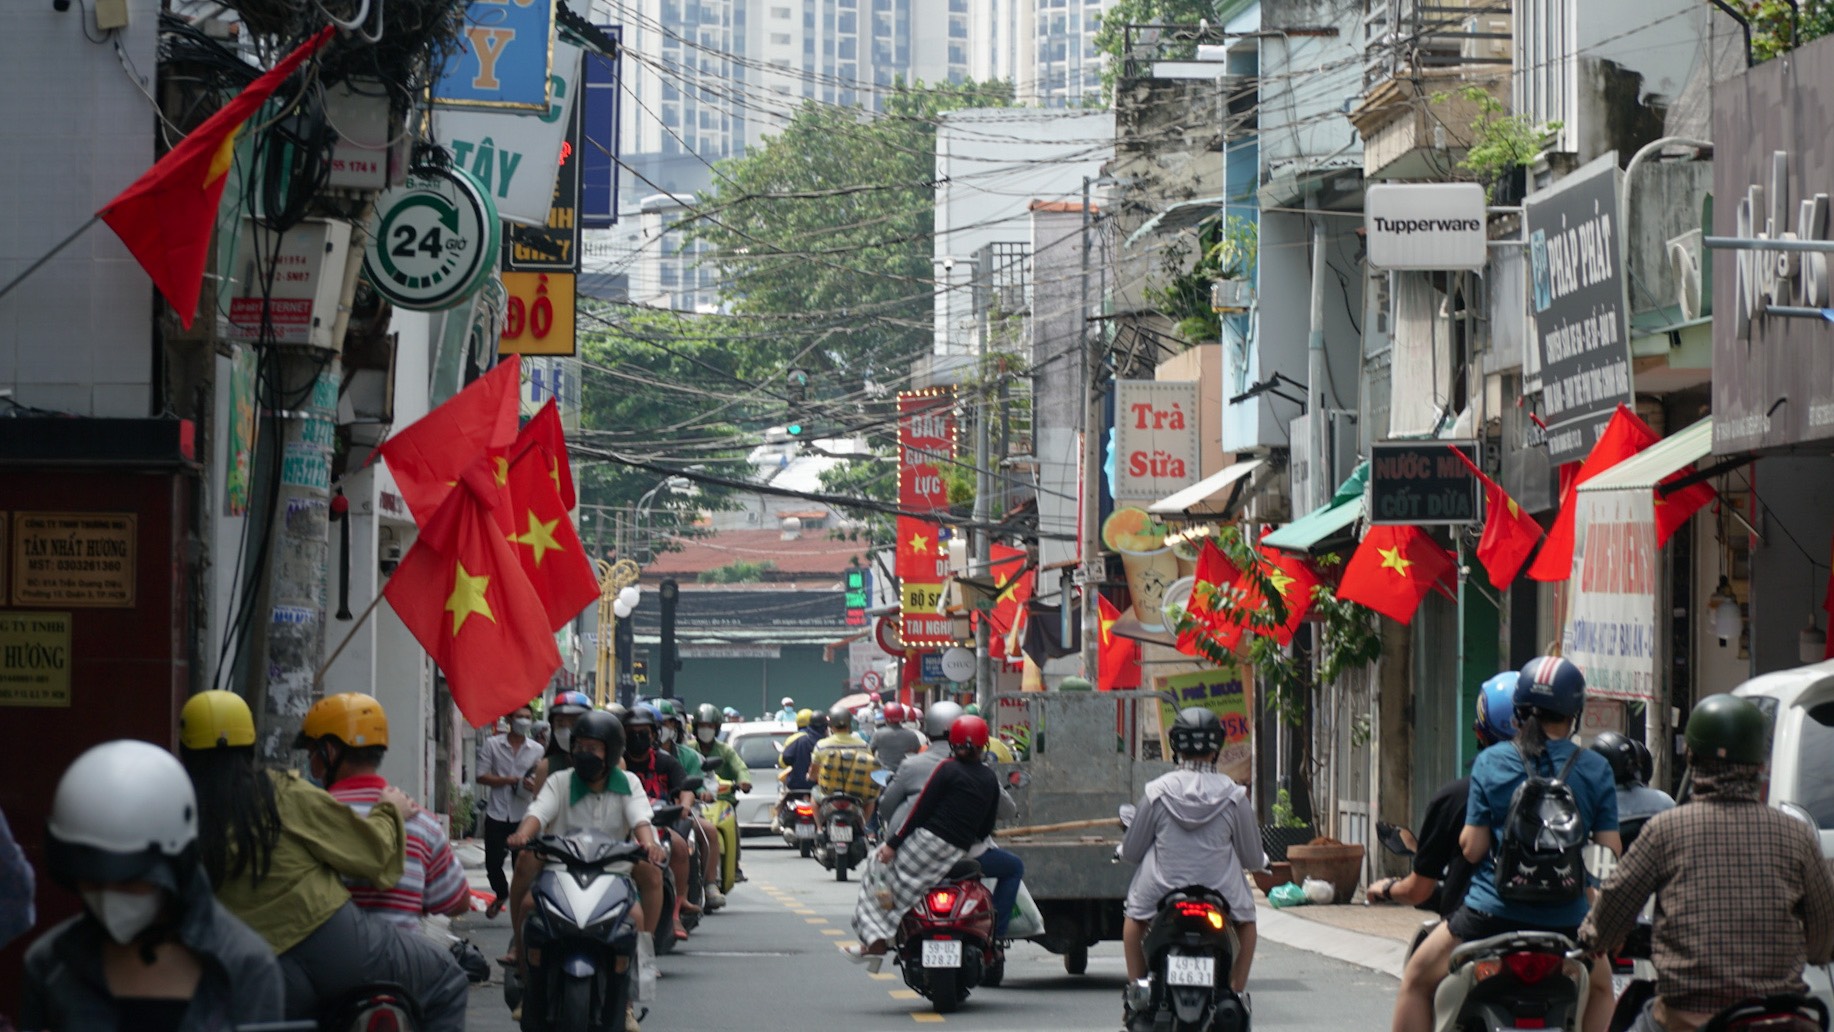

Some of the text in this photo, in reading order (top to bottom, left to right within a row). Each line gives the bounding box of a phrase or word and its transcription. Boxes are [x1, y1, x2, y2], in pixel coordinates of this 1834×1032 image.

[1373, 216, 1481, 235] Tupperware
[392, 224, 443, 259] 24
[1547, 198, 1613, 300] PHÁP PHÁT
[1131, 402, 1186, 431] Trà
[1128, 450, 1187, 479] Sữa
[1376, 451, 1431, 480] NƯỚC
[1380, 487, 1470, 516] CỐT DỪA
[24, 533, 47, 556] TÂN
[50, 531, 83, 557] NHẤT
[910, 590, 925, 610] BỘ
[906, 620, 923, 635] TAI
